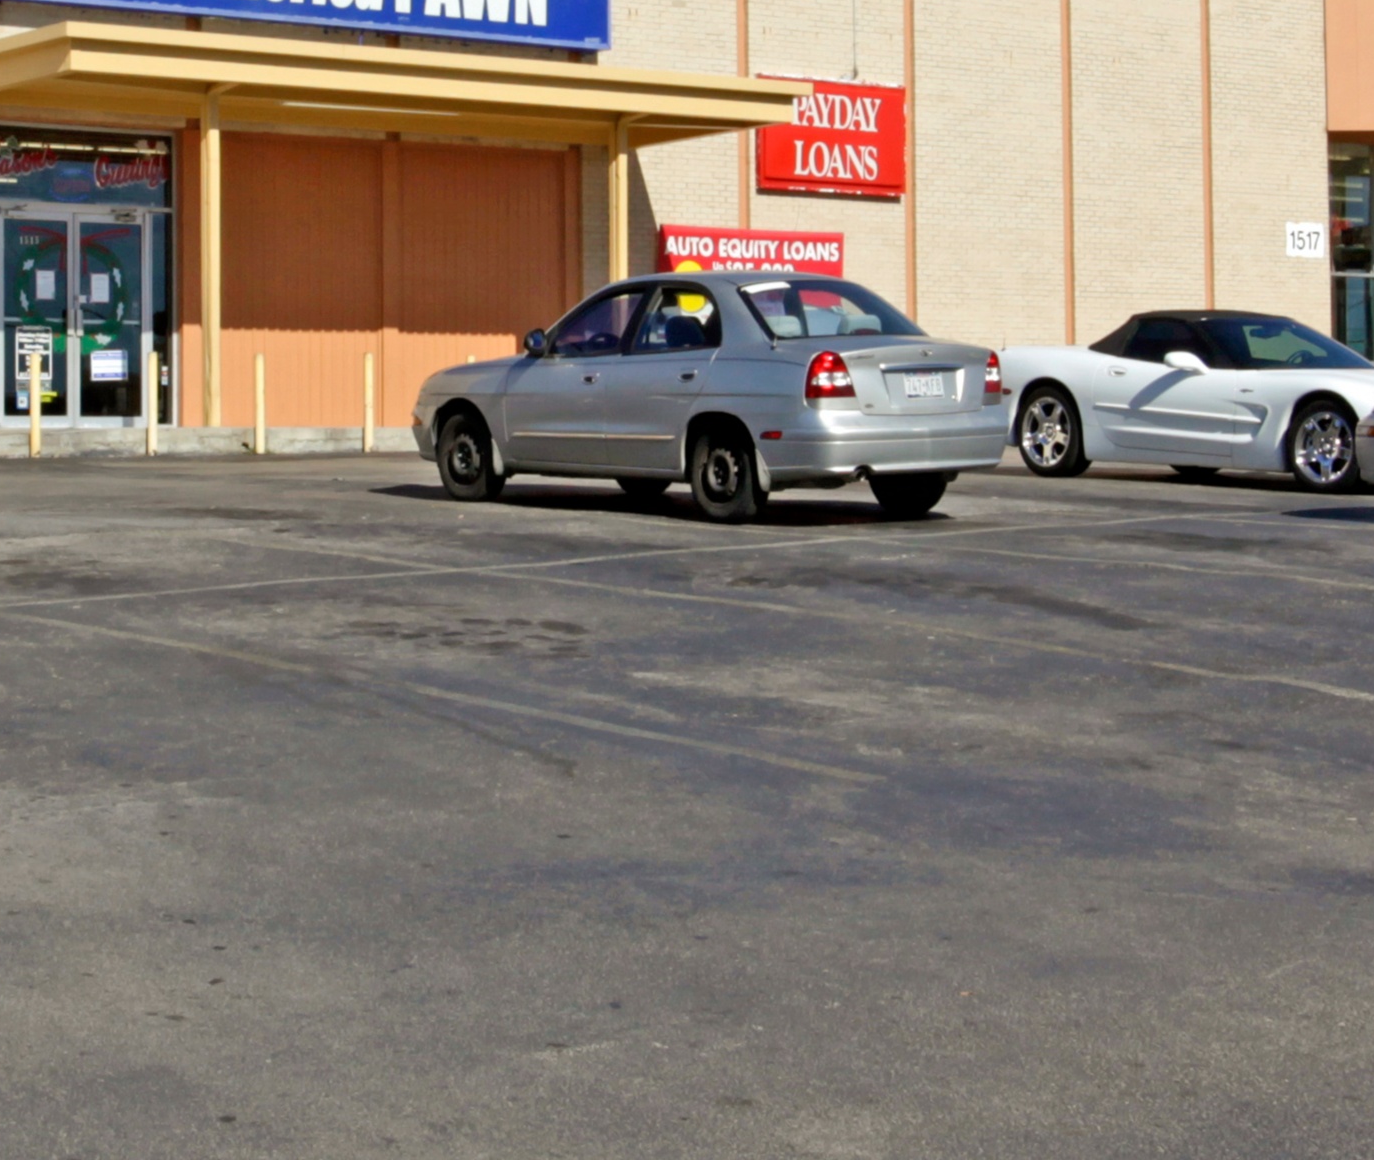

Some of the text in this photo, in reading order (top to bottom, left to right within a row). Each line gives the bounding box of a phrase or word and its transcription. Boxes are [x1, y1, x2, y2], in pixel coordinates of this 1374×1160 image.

[791, 93, 882, 132] PAYDAY
[793, 140, 879, 181] LOANS
[664, 236, 840, 262] AUTO EQUITY LOANS
[1289, 230, 1321, 251] 1517
